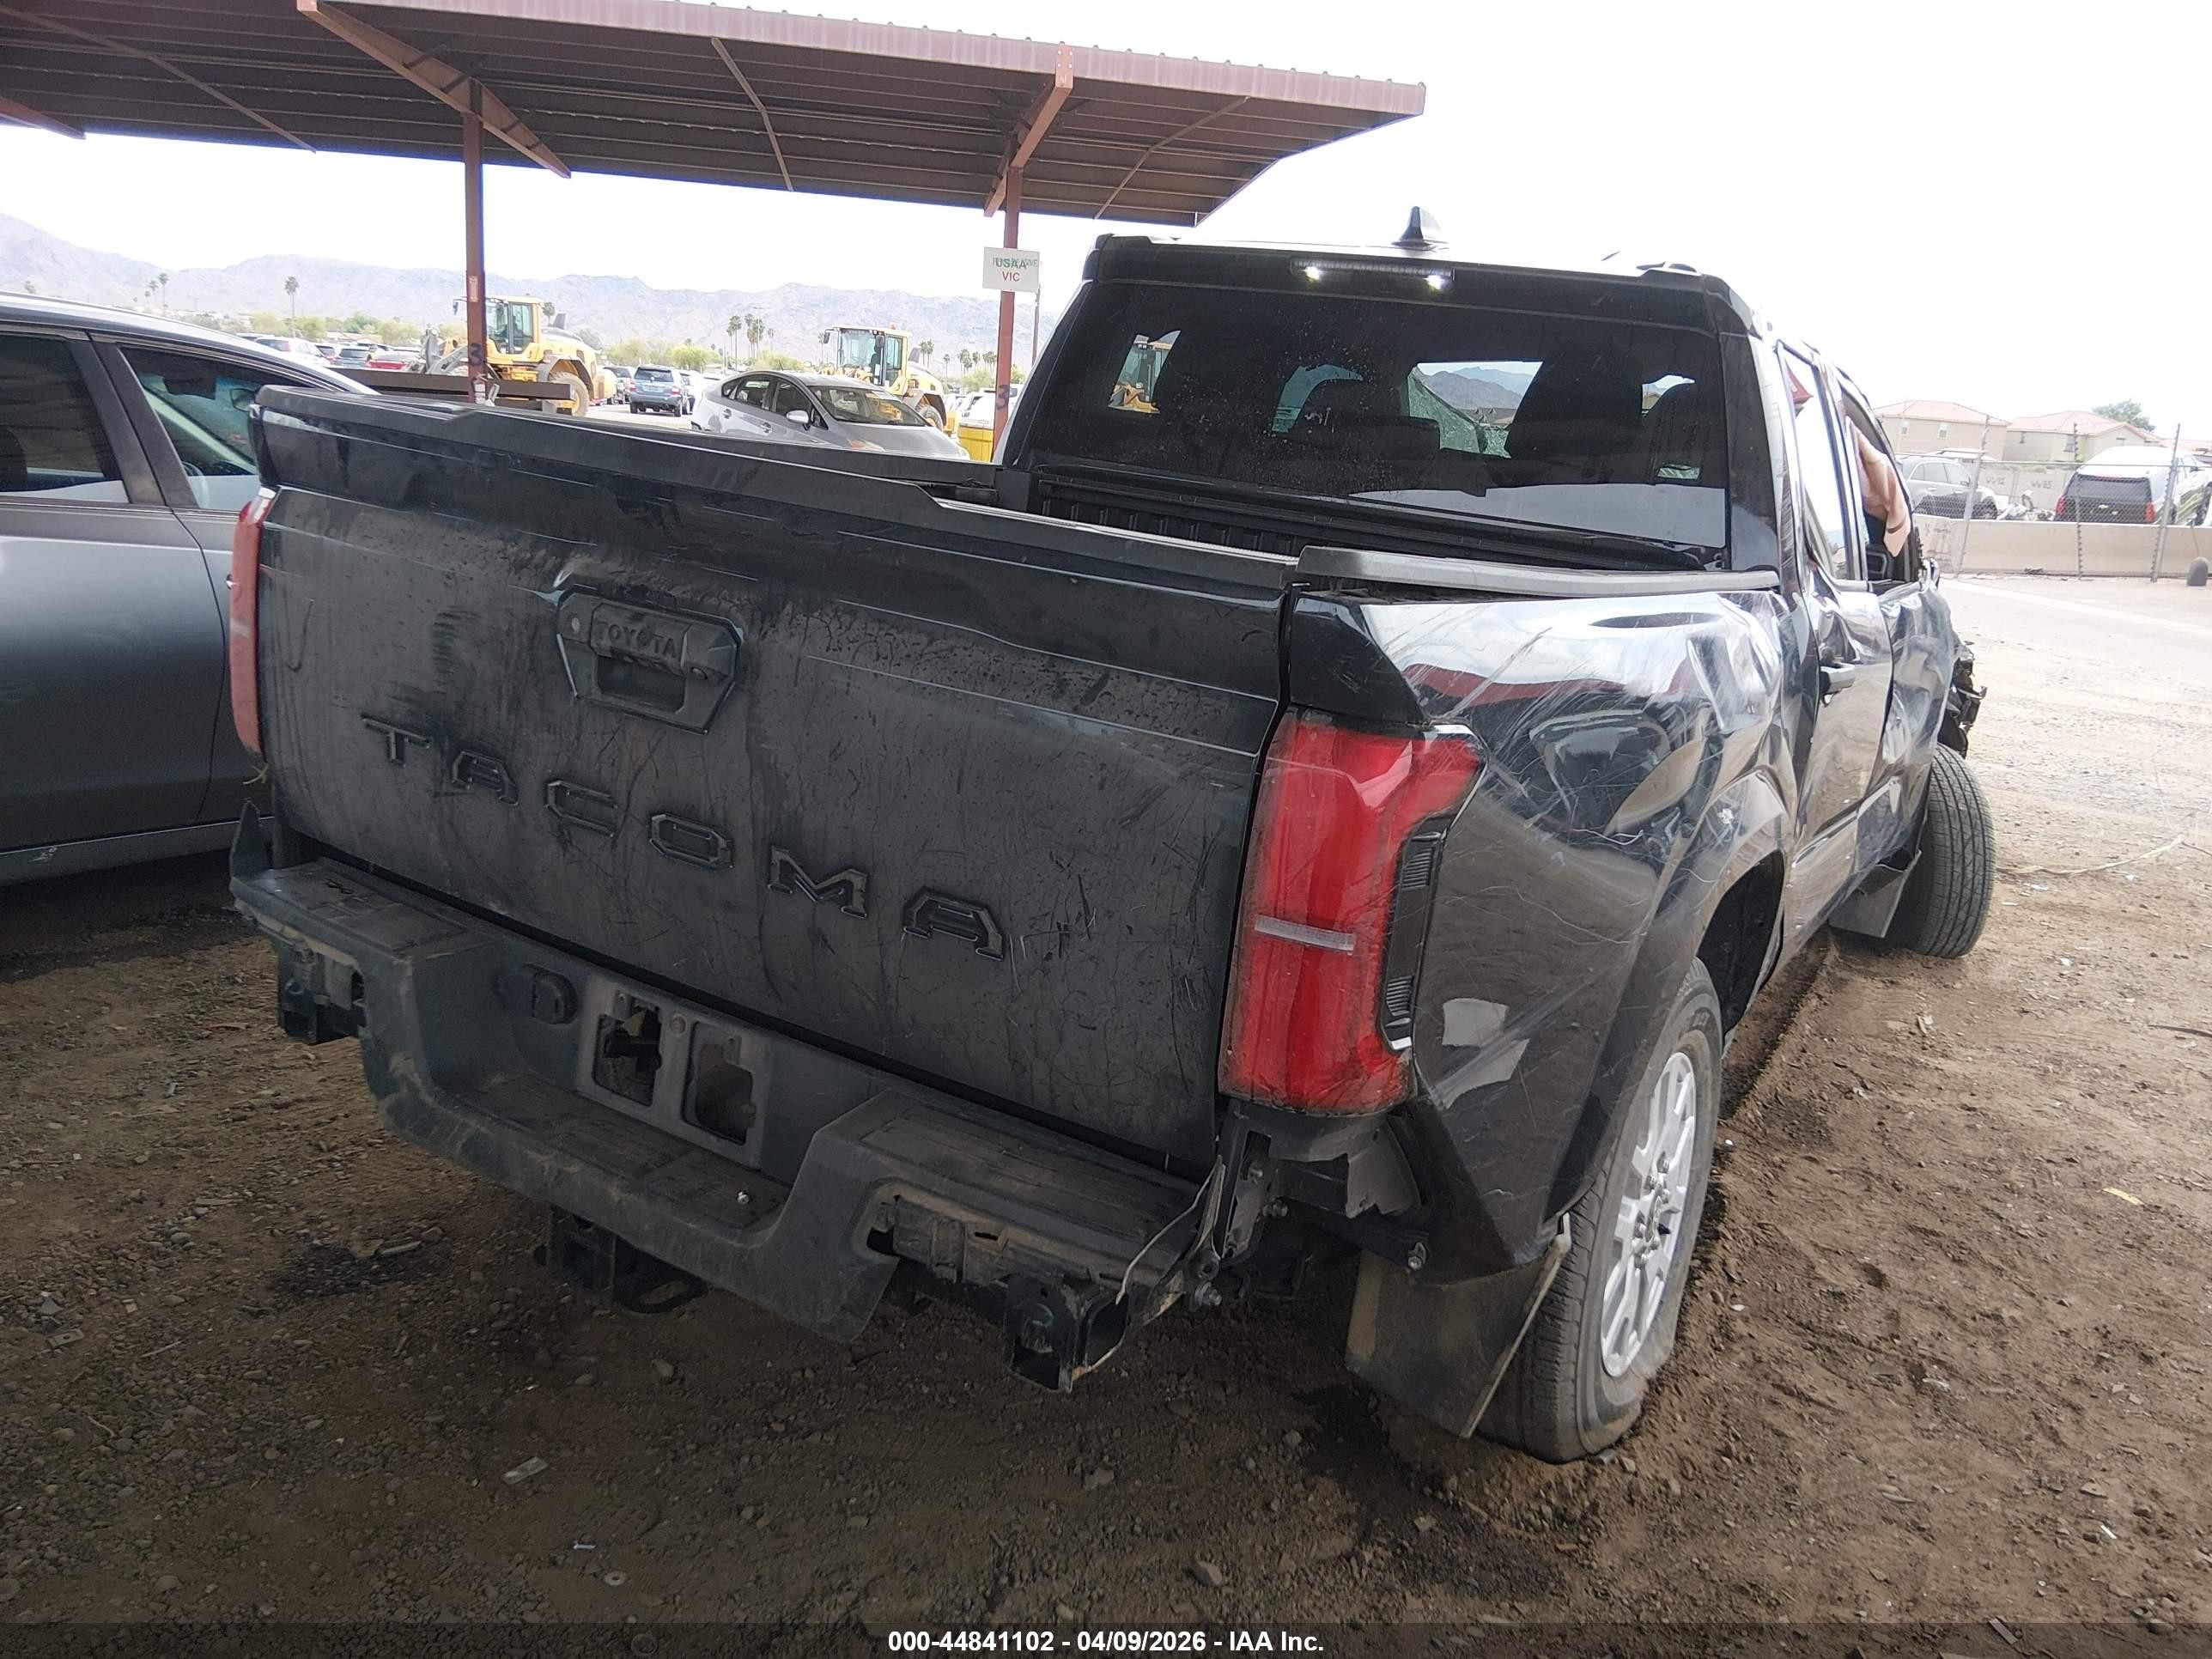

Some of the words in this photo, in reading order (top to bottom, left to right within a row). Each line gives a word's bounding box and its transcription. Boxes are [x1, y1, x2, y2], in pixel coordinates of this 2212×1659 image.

[995, 257, 1027, 270] USAA
[1002, 270, 1020, 282] VIC
[596, 620, 678, 659] TOYOTA
[361, 714, 1006, 961] TACOMA
